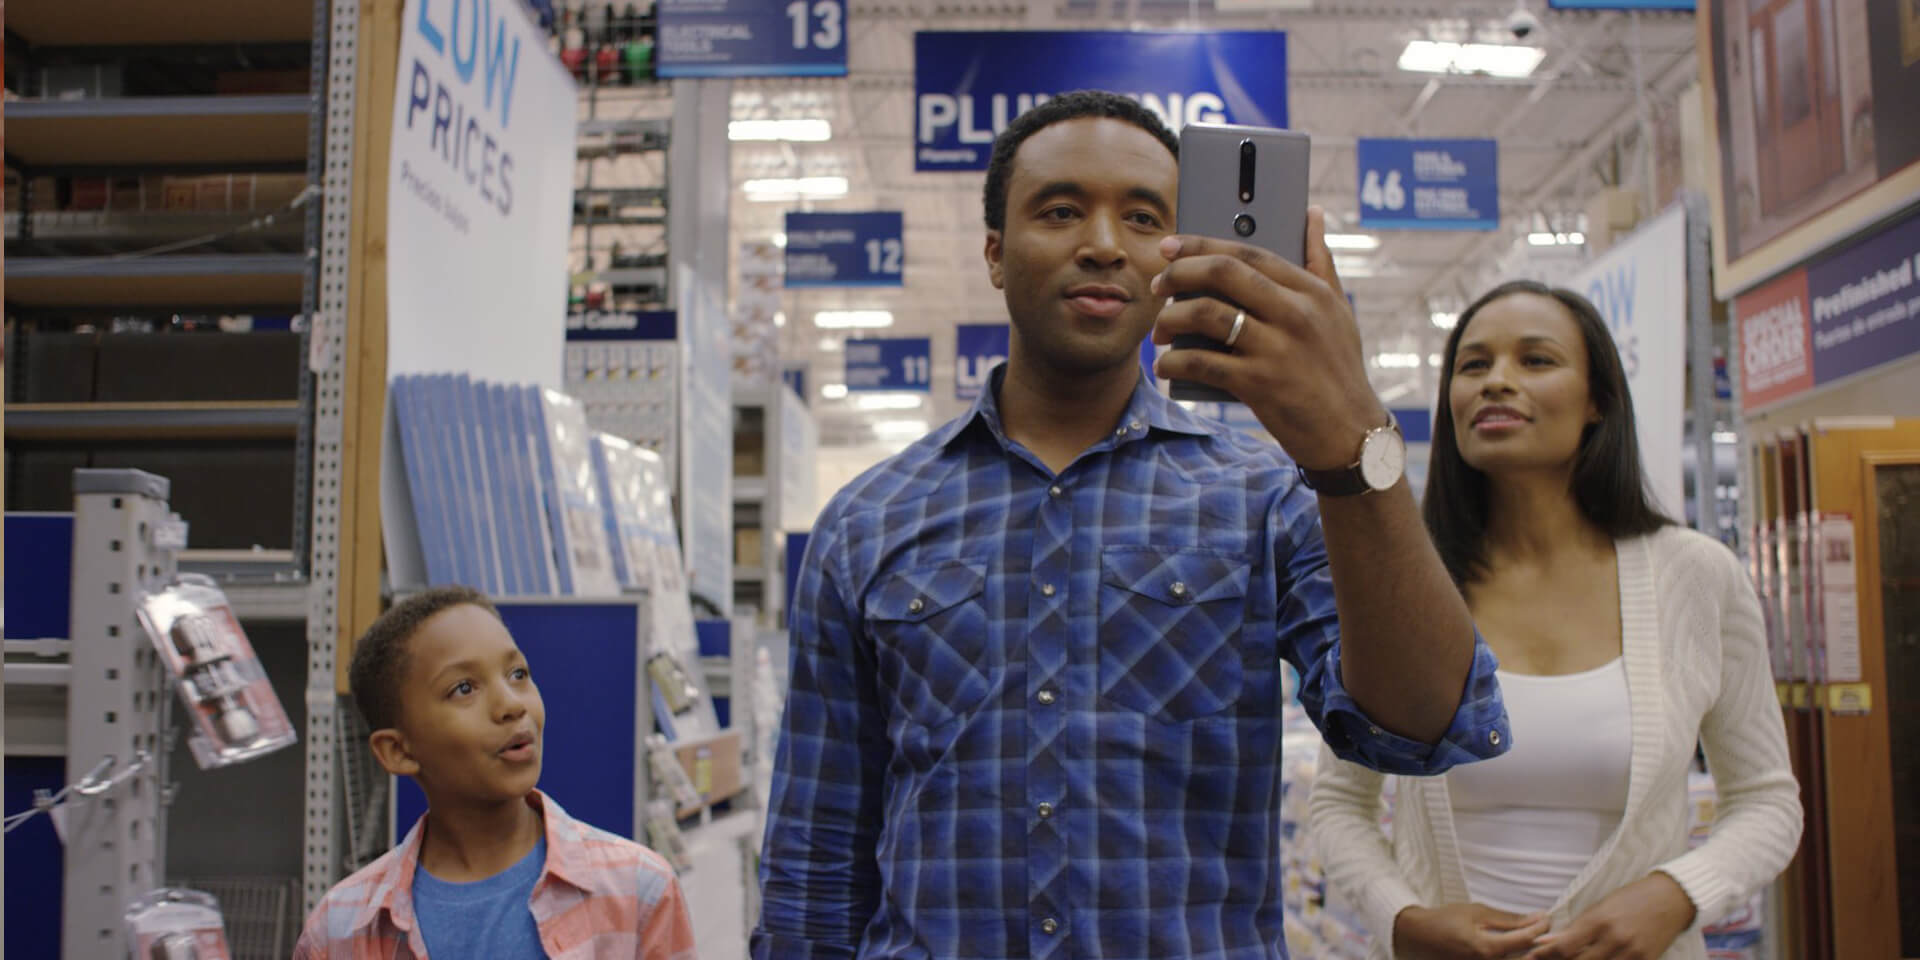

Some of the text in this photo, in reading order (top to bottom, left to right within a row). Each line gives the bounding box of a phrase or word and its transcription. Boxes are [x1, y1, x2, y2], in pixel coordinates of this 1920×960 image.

[787, 1, 841, 49] 13
[408, 57, 514, 216] PRICES
[1362, 169, 1405, 211] 46
[864, 239, 901, 274] 12
[1589, 255, 1638, 333] OW
[1814, 257, 1912, 323] Prefinished
[1743, 297, 1804, 346] SPECIAL
[902, 356, 929, 384] 11
[1744, 325, 1805, 377] ORDER
